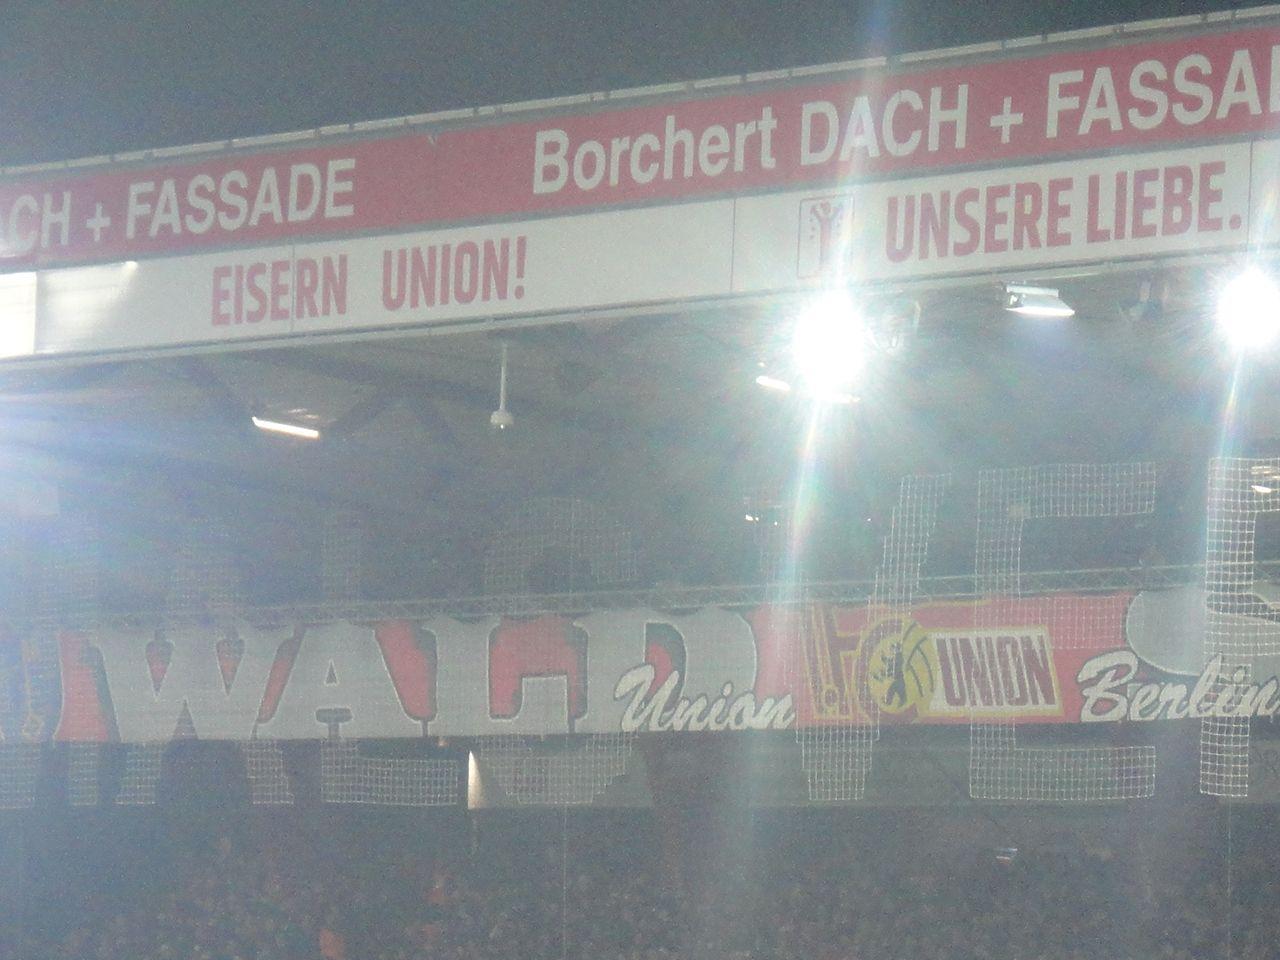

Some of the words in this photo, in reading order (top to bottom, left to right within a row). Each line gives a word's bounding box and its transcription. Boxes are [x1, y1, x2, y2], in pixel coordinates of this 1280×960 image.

[532, 107, 777, 195] Borchert
[800, 83, 968, 165] DACH
[990, 96, 1024, 144] +
[125, 158, 356, 239] FASSADE
[885, 177, 1074, 263] UNSERE
[1087, 162, 1243, 240] LIEBE.
[211, 254, 348, 326] EISERN
[381, 237, 528, 311] UNION!
[90, 608, 758, 744] WALD
[614, 664, 798, 733] Union
[936, 634, 1057, 707] UNION
